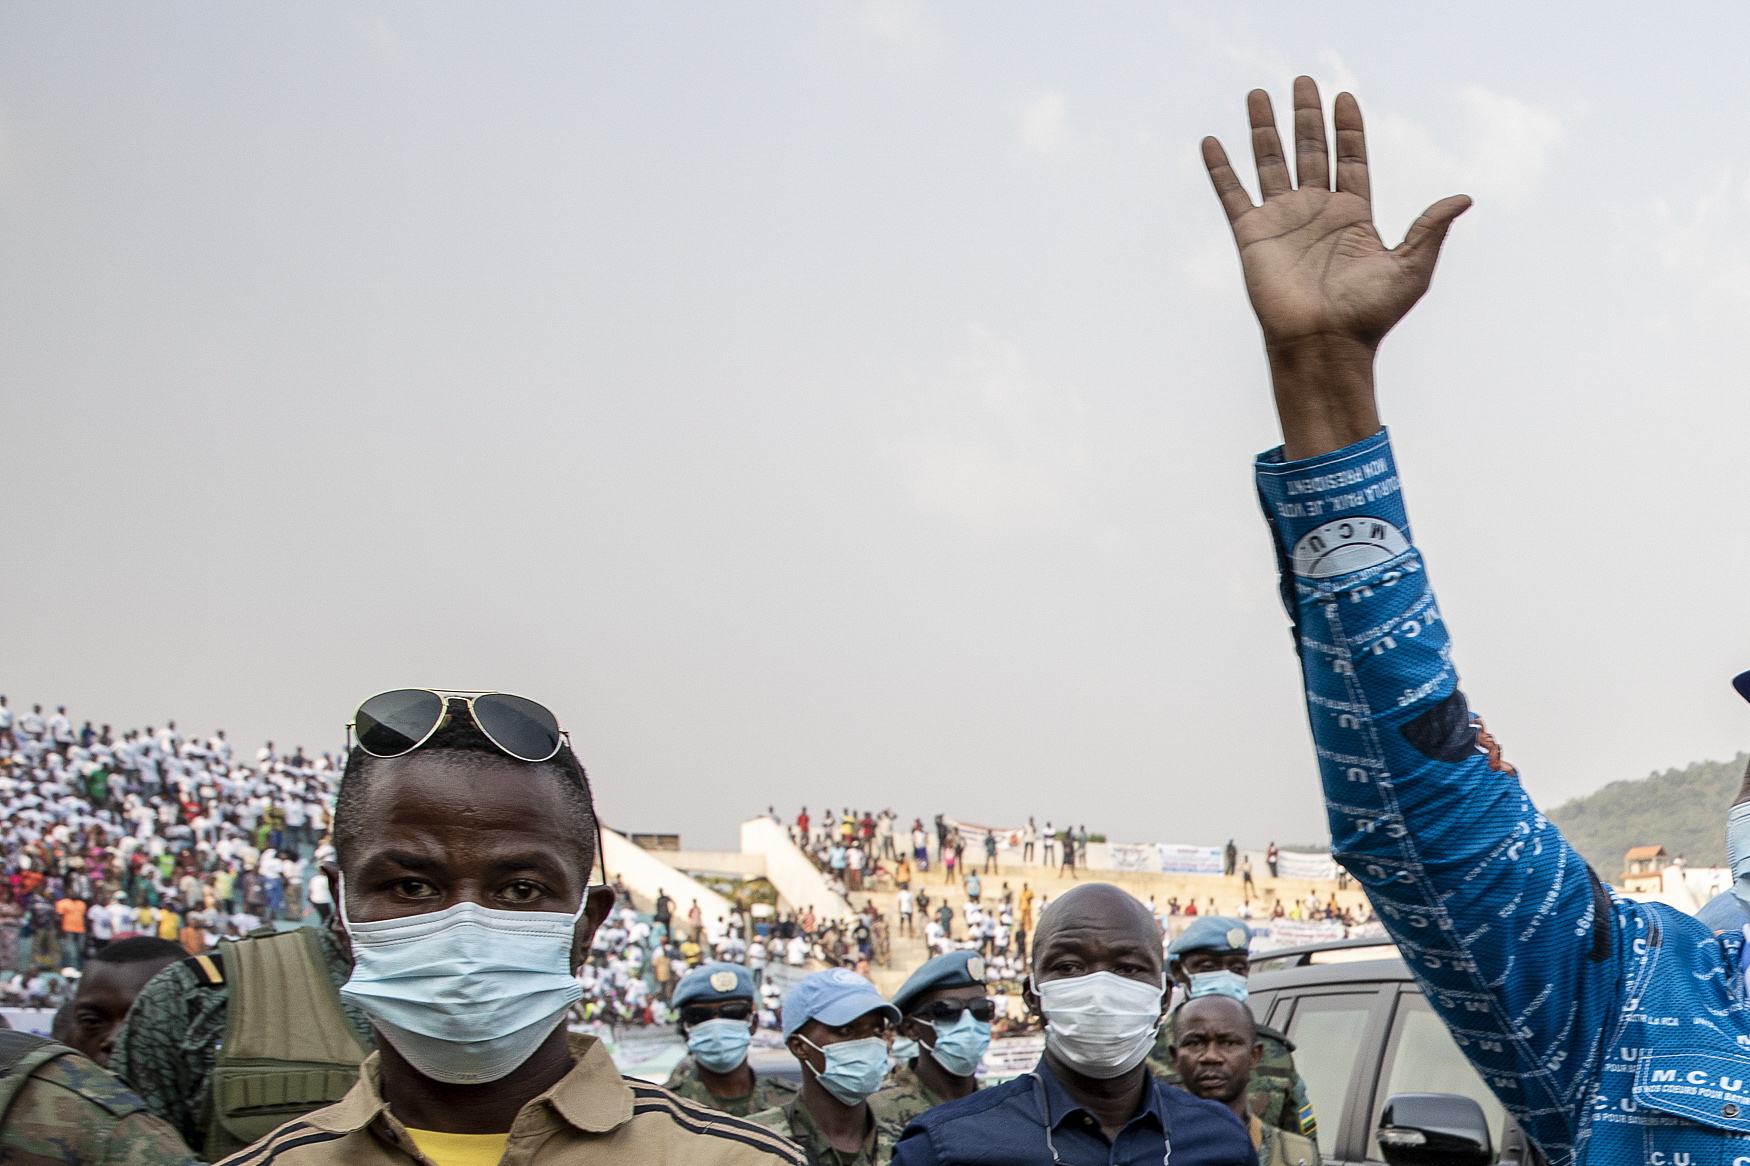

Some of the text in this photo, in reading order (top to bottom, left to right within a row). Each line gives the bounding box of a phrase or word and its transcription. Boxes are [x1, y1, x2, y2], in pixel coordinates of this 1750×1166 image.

[1652, 1070, 1748, 1094] M.C.U.
[1662, 1085, 1697, 1096] COEURS
[1698, 1089, 1724, 1100] POUR
[1724, 1092, 1750, 1106] BATIR
